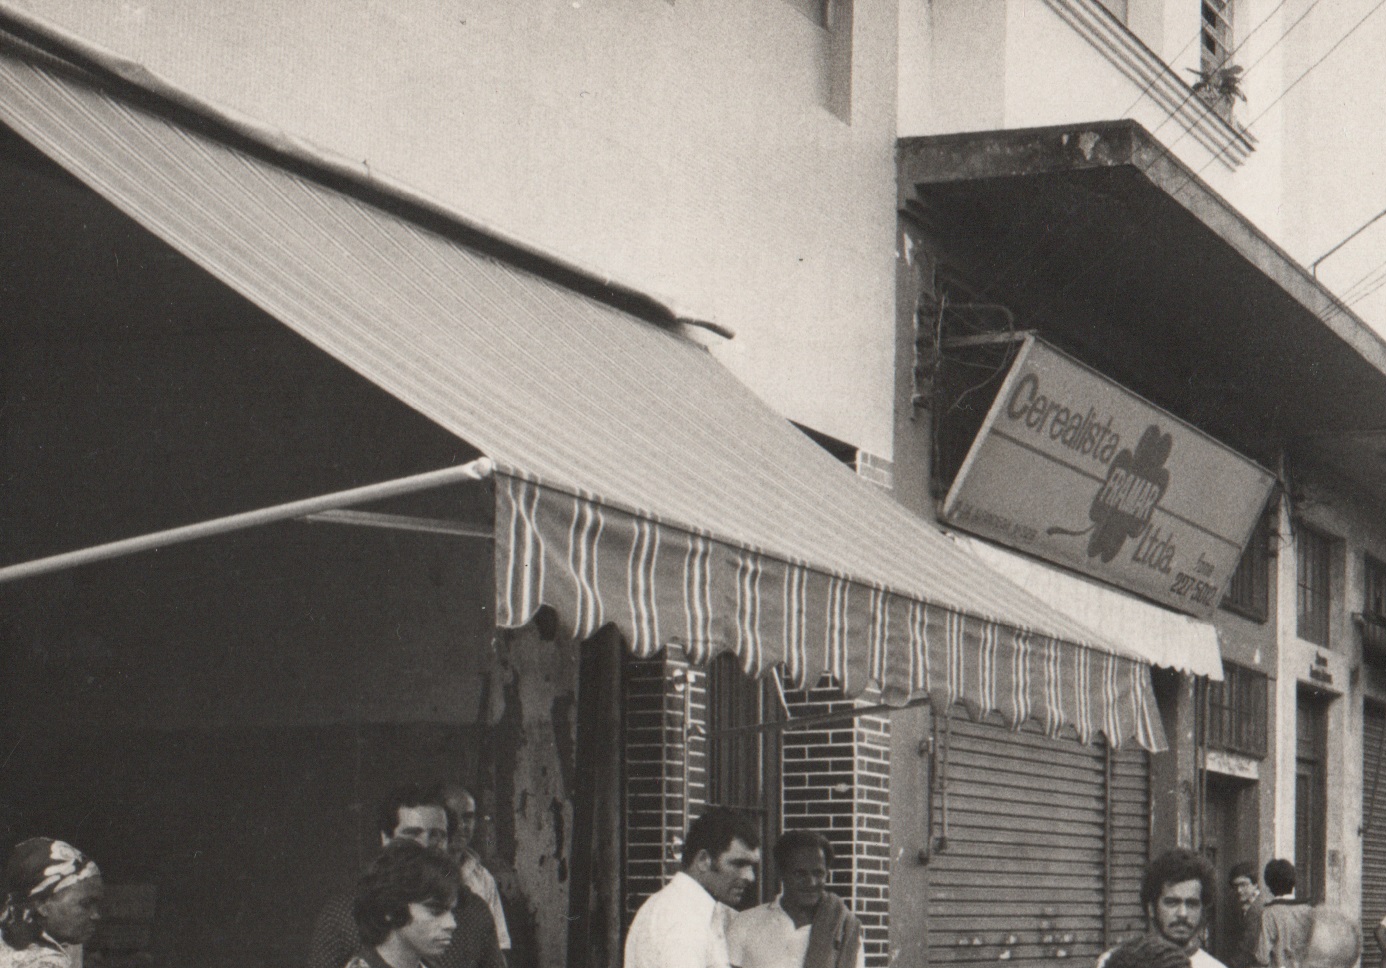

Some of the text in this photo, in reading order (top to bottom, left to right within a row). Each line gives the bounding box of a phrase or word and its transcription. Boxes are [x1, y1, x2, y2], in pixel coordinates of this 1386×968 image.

[1007, 372, 1120, 465] Cerealista
[1100, 466, 1160, 521] FRAMAR
[1131, 522, 1176, 575] Ltda.
